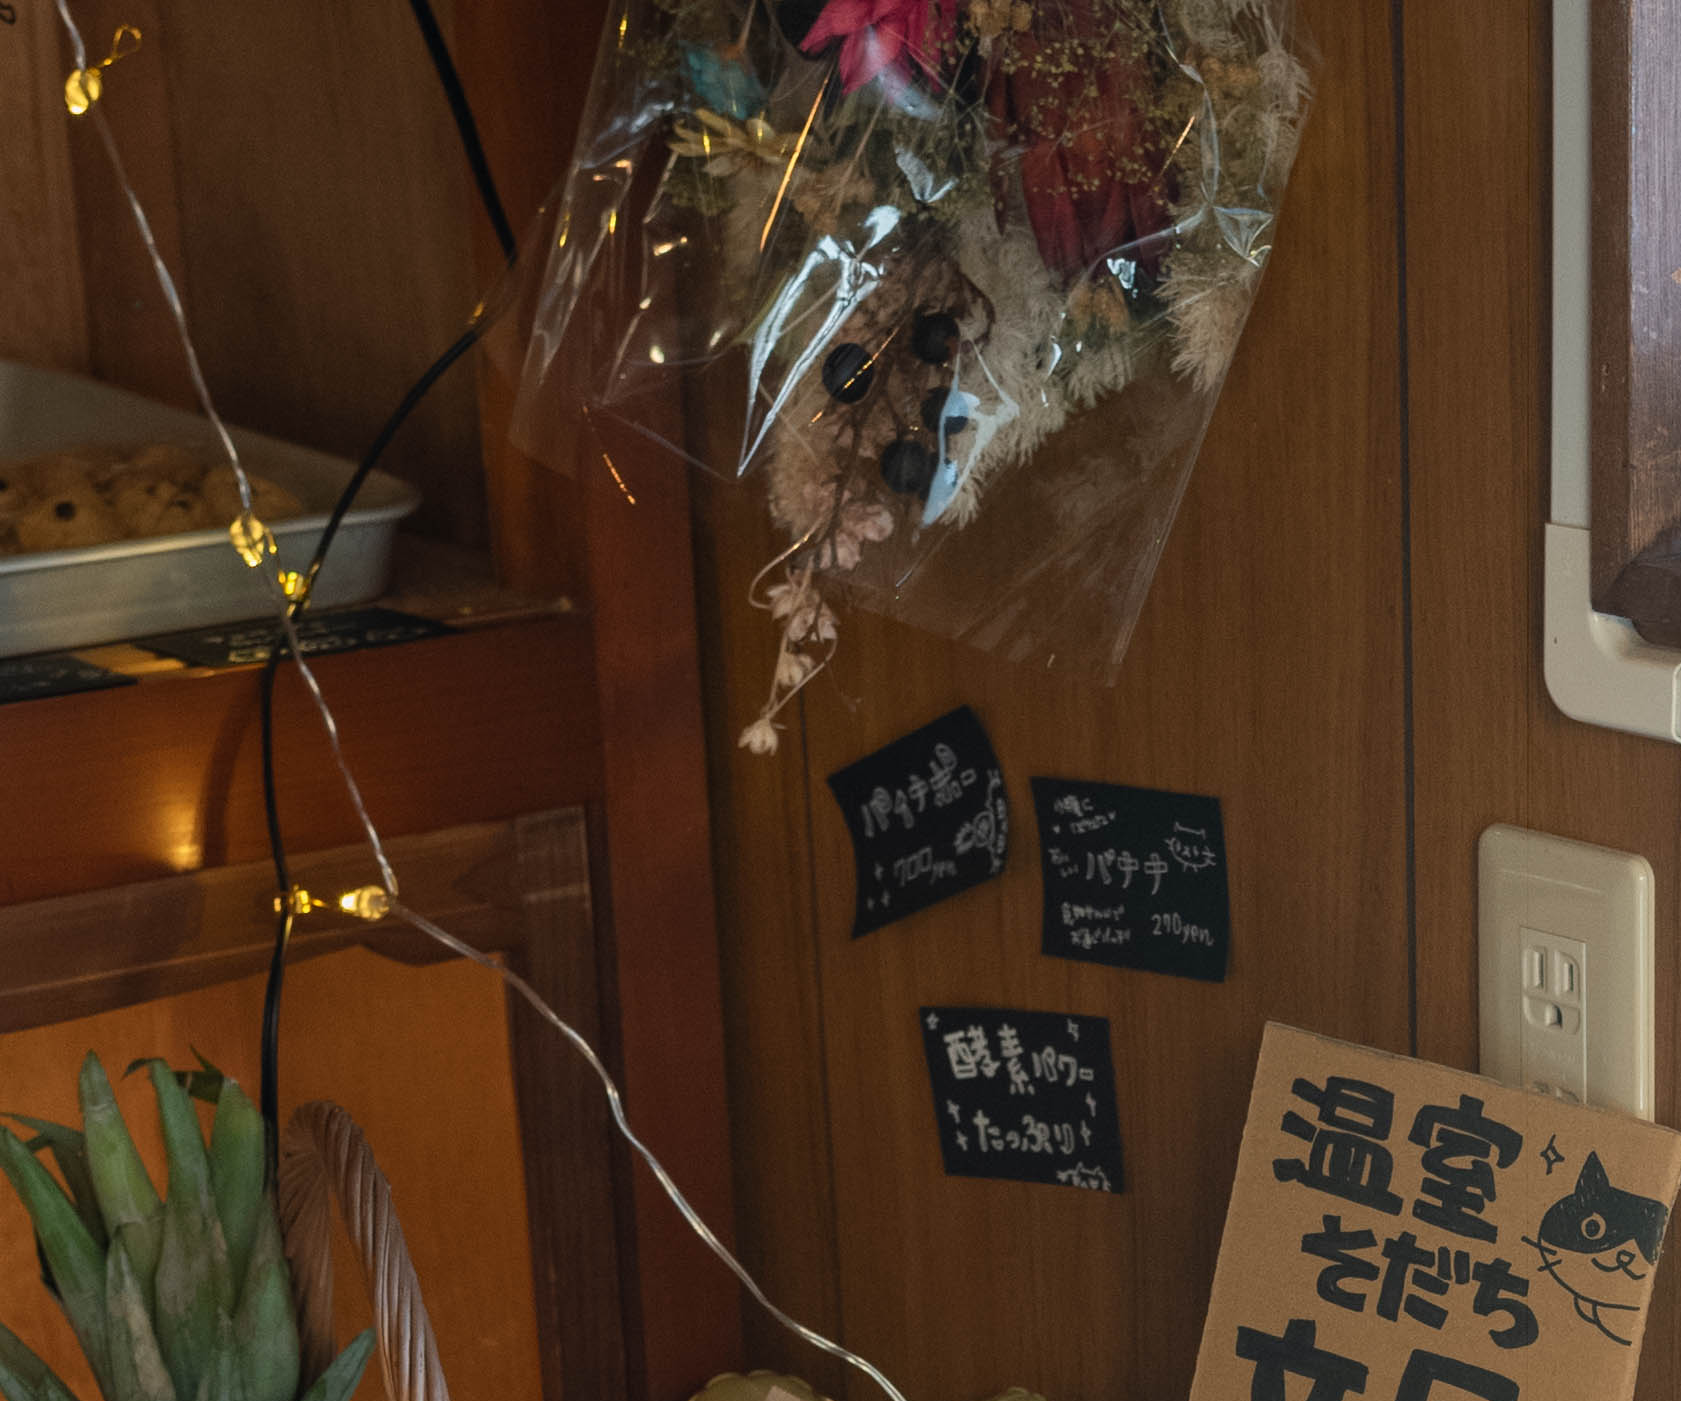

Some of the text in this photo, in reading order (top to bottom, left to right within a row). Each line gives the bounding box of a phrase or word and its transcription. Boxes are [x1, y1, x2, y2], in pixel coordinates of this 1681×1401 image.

[973, 1110, 1077, 1155] たっぷり
[1270, 1074, 1524, 1246] 温室
[1300, 1212, 1540, 1350] そだち
